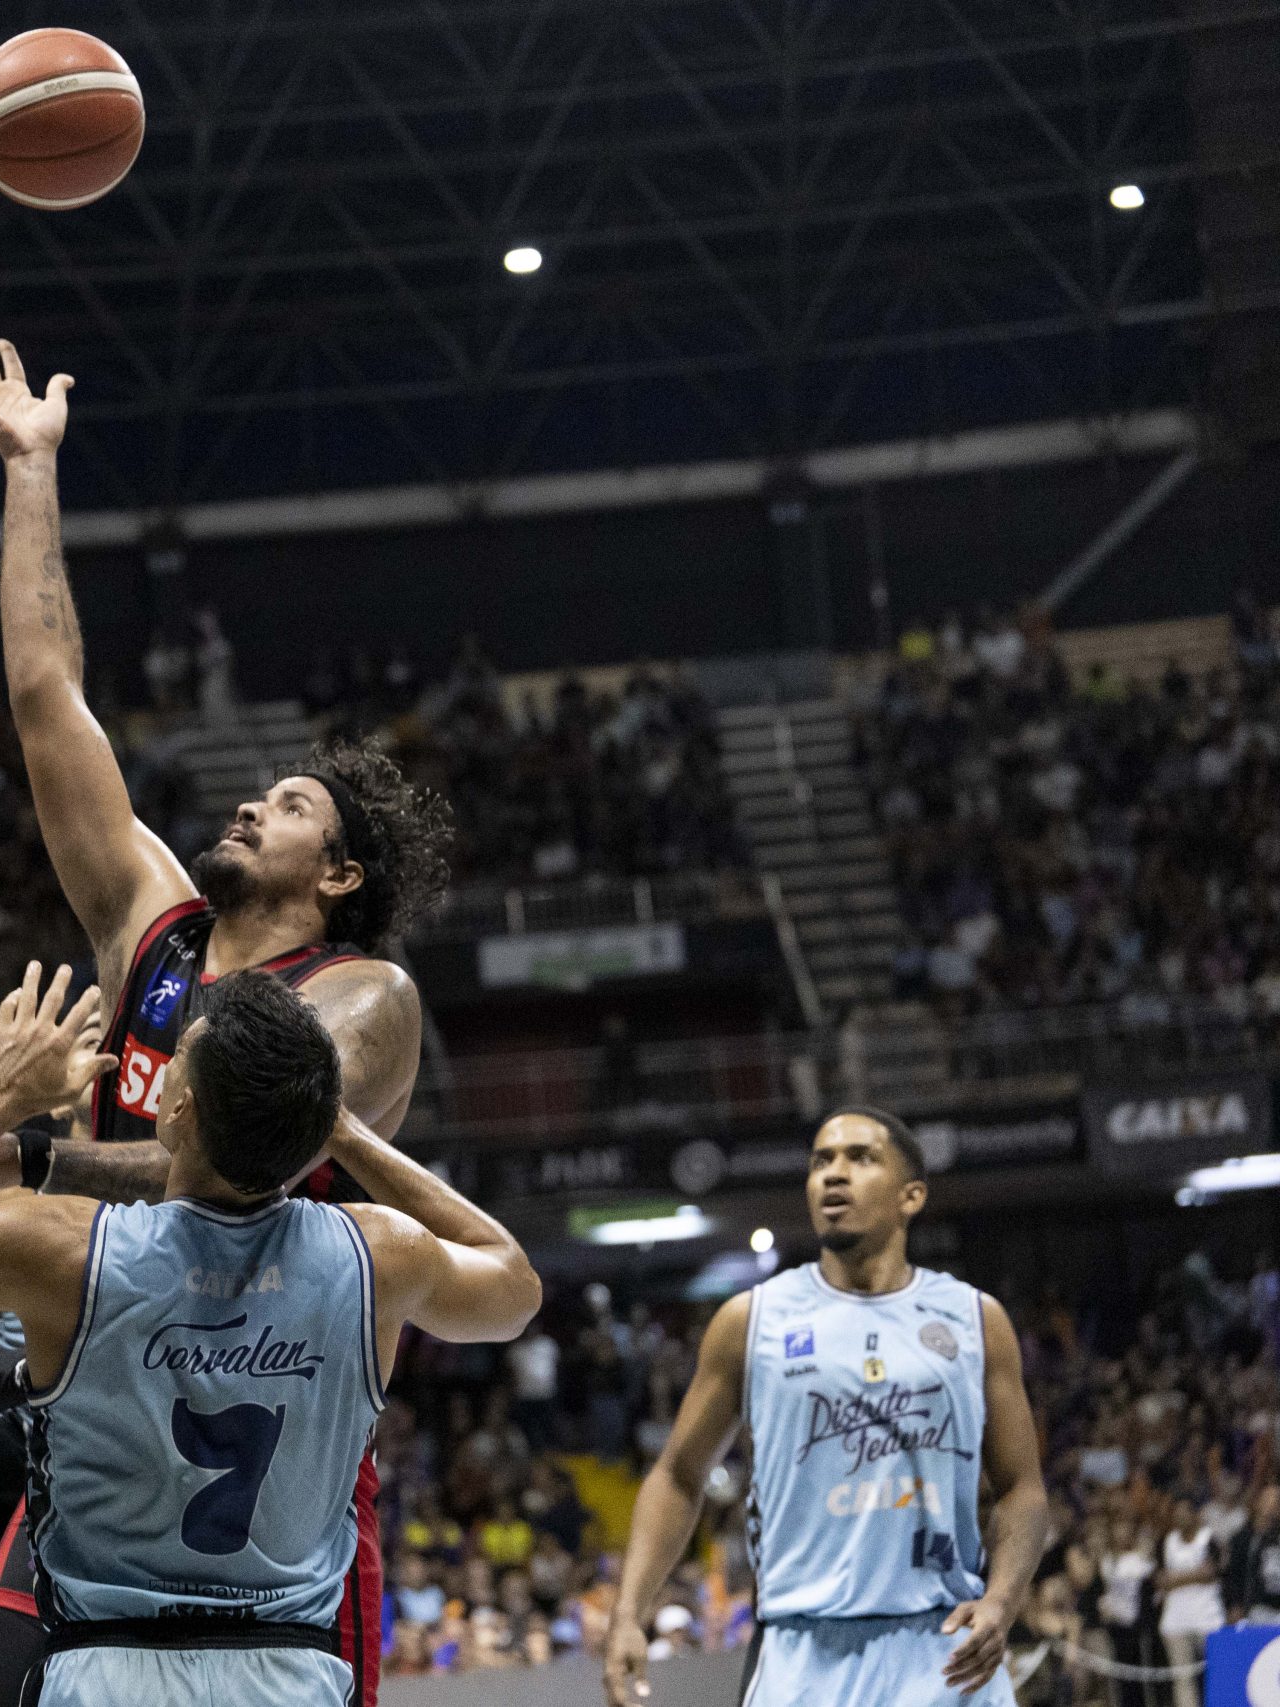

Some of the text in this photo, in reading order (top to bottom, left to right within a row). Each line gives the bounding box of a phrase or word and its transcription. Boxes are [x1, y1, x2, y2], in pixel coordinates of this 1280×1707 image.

[1108, 1095, 1249, 1142] CAIXA
[143, 1312, 325, 1381] Corvalan
[171, 1398, 286, 1556] 7
[184, 1583, 286, 1601] Heavenly
